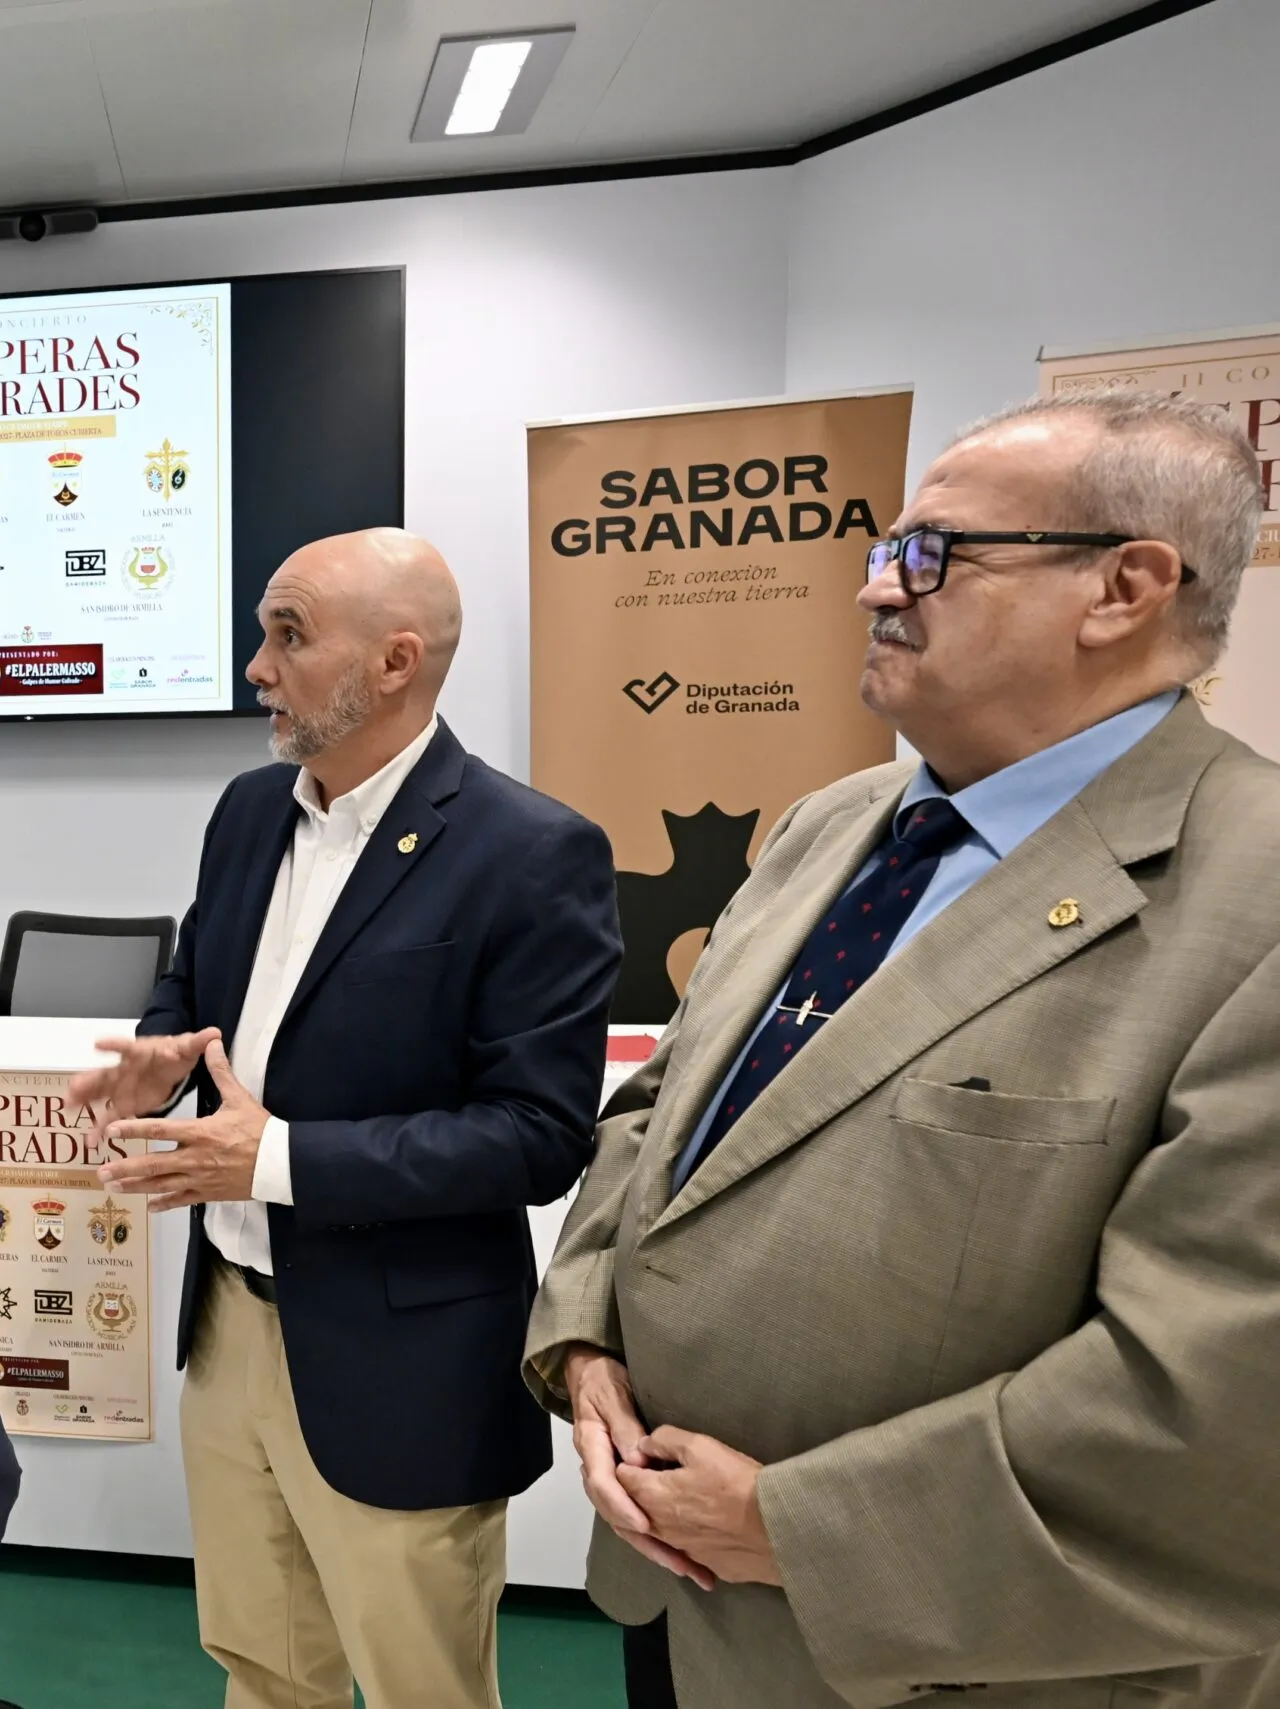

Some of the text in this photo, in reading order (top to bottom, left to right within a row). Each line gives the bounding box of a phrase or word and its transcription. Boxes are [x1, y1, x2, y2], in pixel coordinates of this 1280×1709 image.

[599, 454, 829, 510] SABOR
[551, 498, 881, 558] GRANADA
[645, 564, 778, 587] En conexión
[614, 584, 811, 608] con nuestra tierra
[5, 662, 96, 677] #ELPALERMASSO
[686, 679, 794, 702] Diputación
[686, 697, 800, 714] de Granada
[31, 1254, 68, 1264] EL CARMEN
[87, 1257, 133, 1268] LA SENTENCIA
[95, 1280, 129, 1291] ARMILLA
[48, 1339, 125, 1352] SAN ISIDRO DE ARMILLA
[7, 1367, 64, 1379] #ELPALERMASSO
[104, 1415, 145, 1423] redentradas
